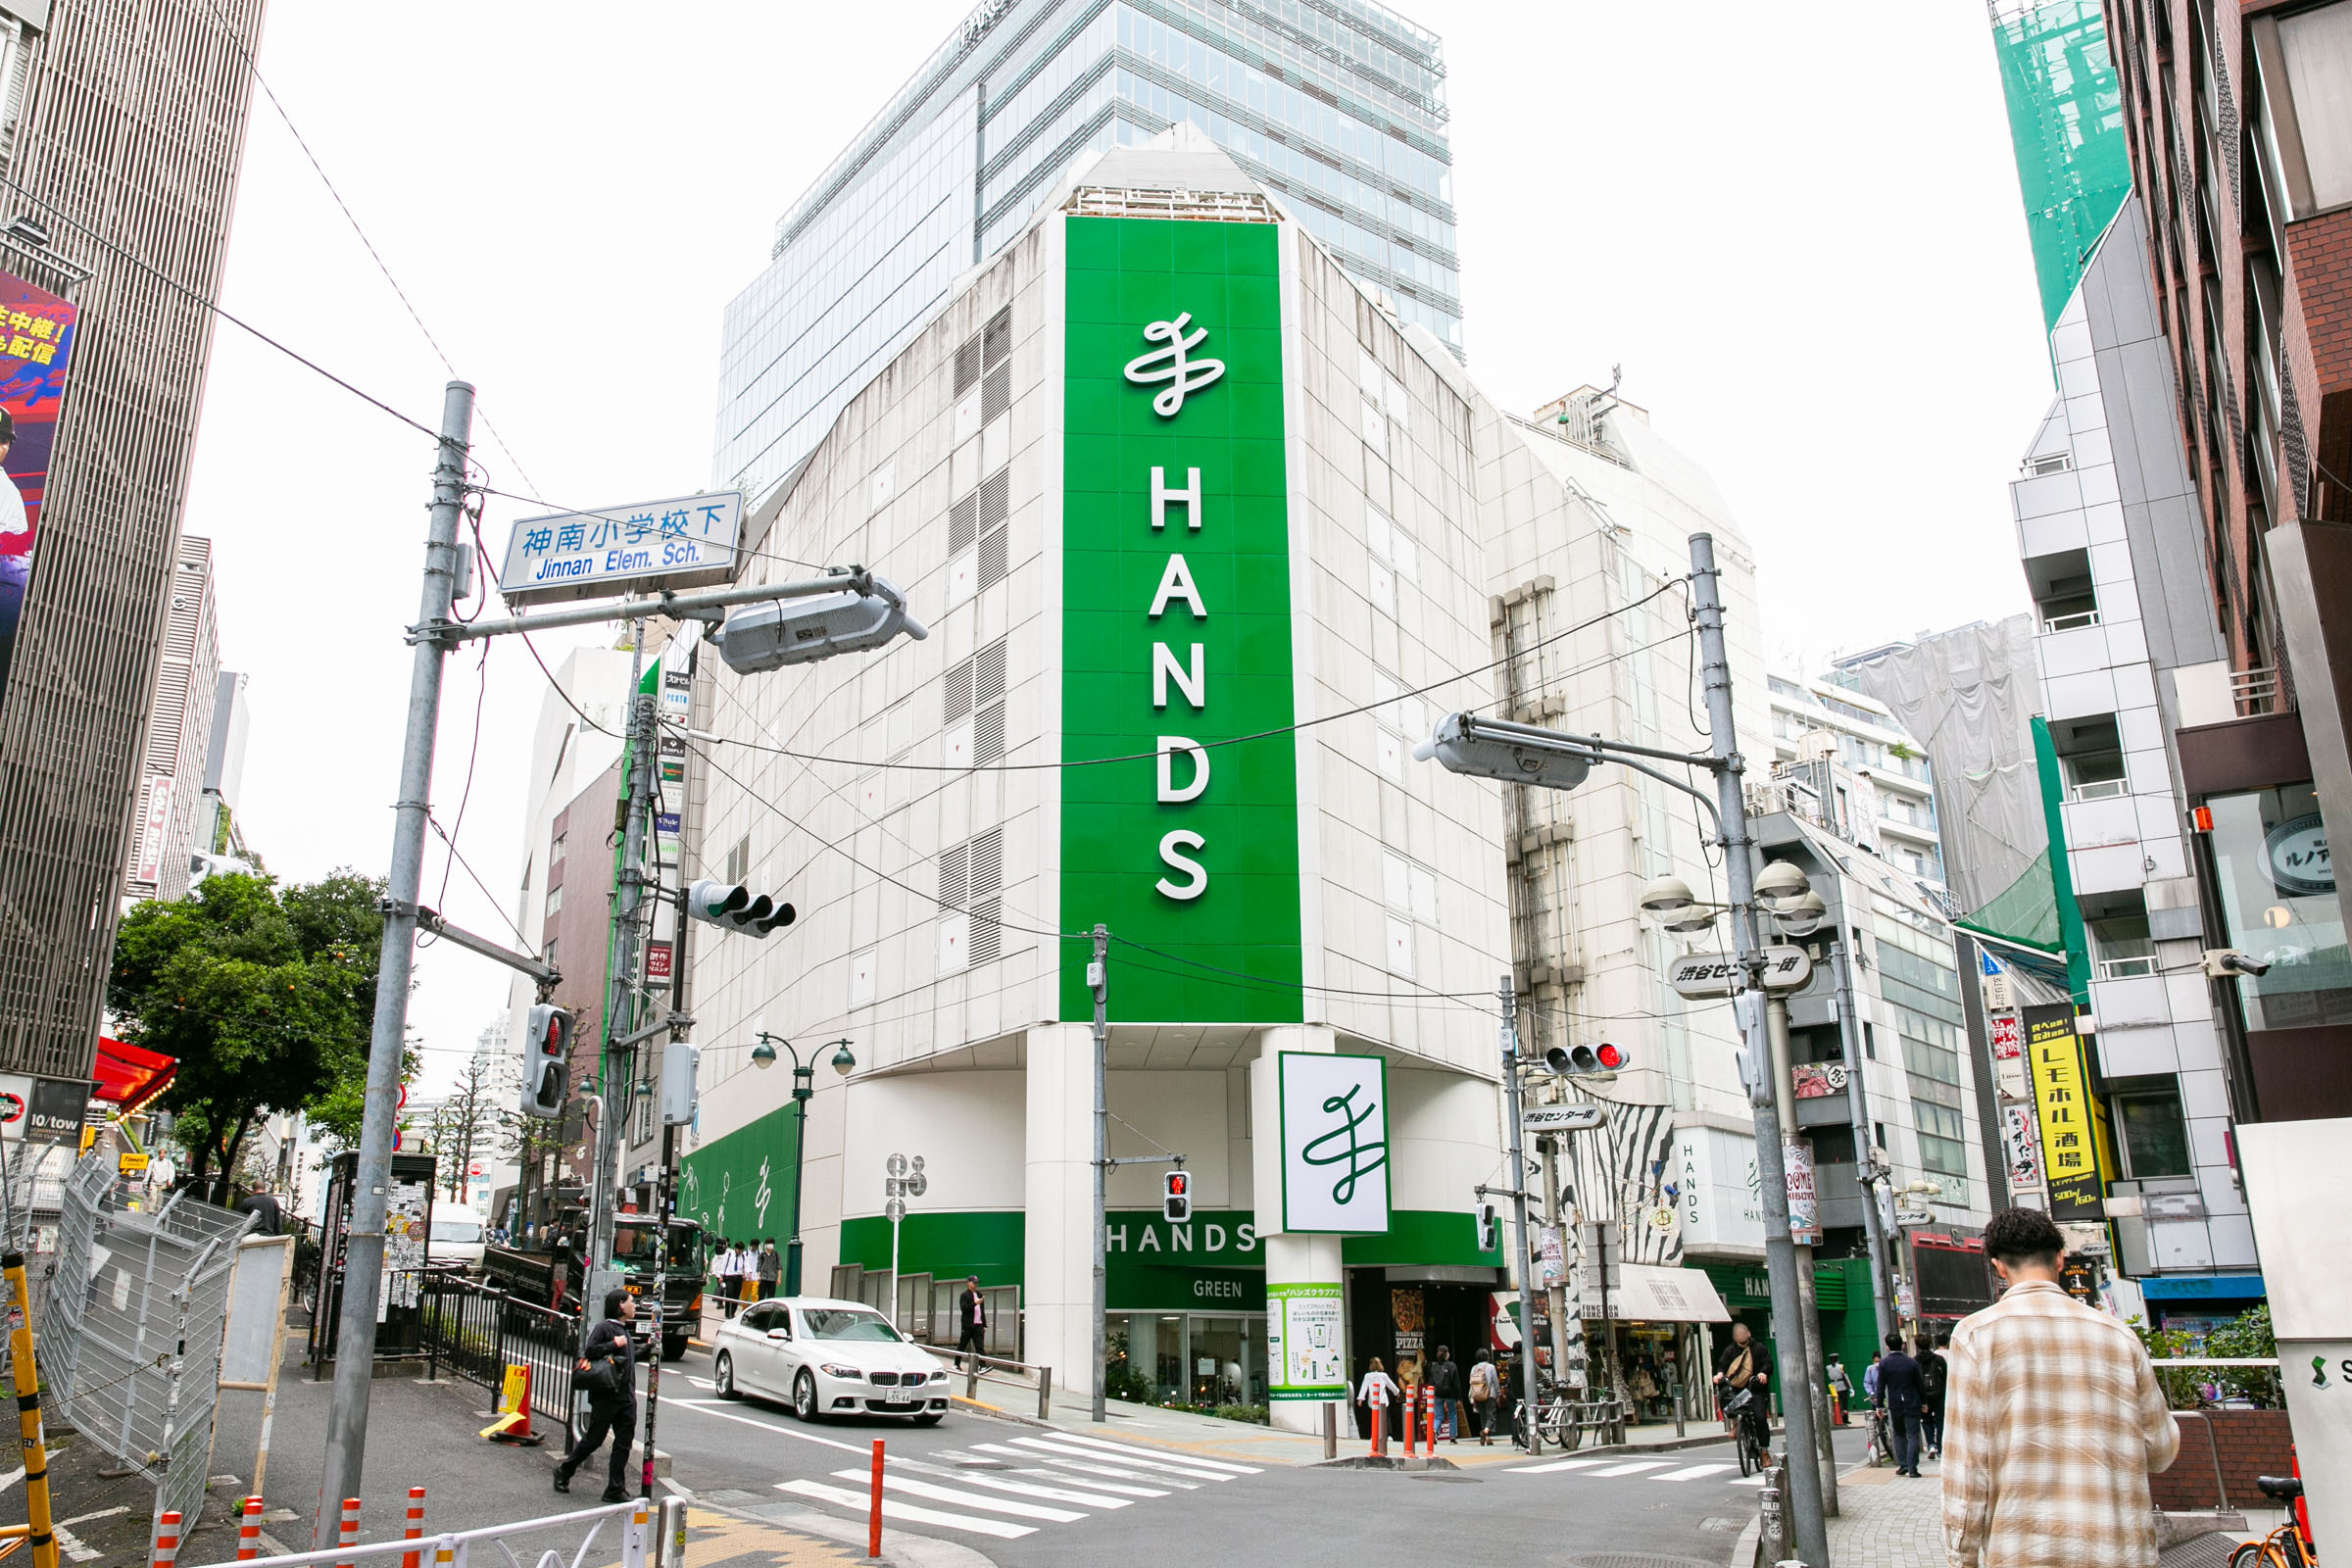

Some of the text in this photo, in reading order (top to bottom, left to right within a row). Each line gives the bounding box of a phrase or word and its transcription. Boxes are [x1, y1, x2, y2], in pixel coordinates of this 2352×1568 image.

[522, 504, 726, 558] 神南小学校下
[536, 541, 700, 580] Jinnan Elem. Sch.
[1148, 466, 1211, 901] HANDS
[144, 786, 168, 865] GOLD RUSH
[1677, 956, 1800, 982] 渋谷センー街
[31, 1113, 78, 1130] 10/tow
[2042, 1048, 2082, 1167] レモホル酒場
[1684, 1145, 1698, 1224] HANDS
[1105, 1223, 1256, 1252] HANDS
[1194, 1280, 1243, 1298] GREEN
[1396, 1338, 1425, 1349] PIZZA
